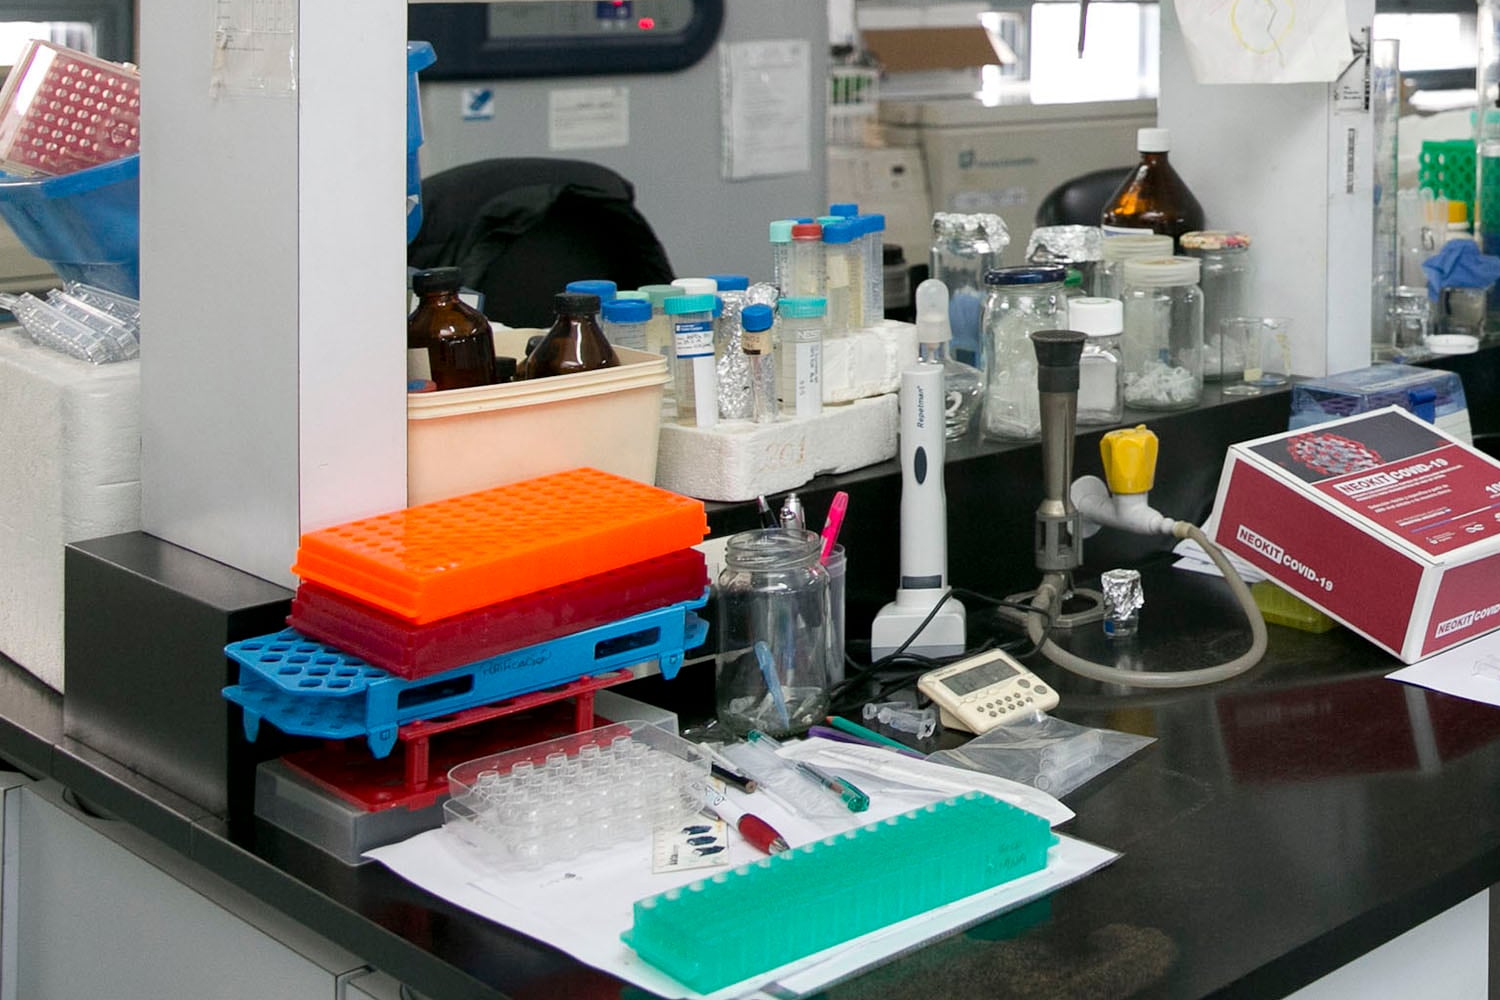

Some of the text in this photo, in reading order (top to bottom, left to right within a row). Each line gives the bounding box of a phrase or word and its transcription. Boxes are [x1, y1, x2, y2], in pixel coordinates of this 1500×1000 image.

[917, 388, 925, 429] Repetman
[1339, 474, 1391, 493] NEOKIT
[1389, 458, 1449, 481] COVID-19
[1239, 528, 1334, 591] NEOKIT COVID-19
[1438, 613, 1473, 635] NEOKIT
